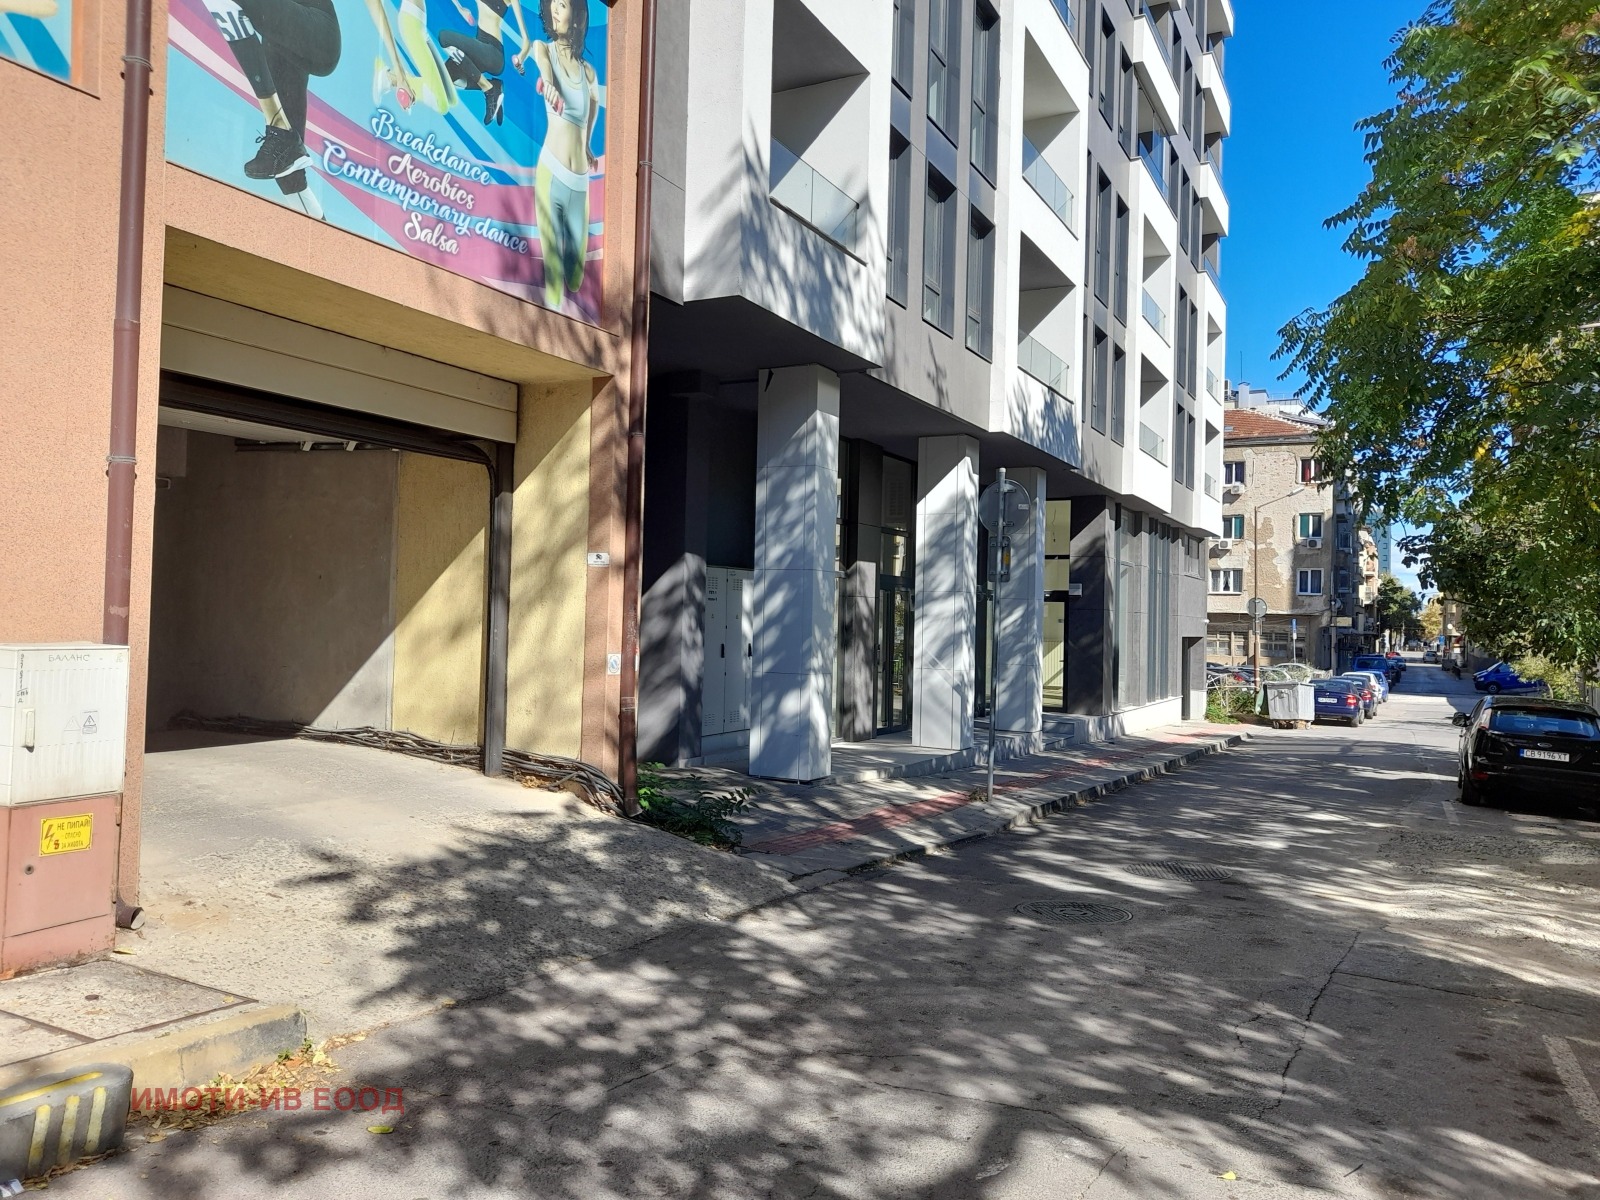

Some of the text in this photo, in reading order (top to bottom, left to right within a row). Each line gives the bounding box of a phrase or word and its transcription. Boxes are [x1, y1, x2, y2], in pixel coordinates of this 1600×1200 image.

[371, 108, 491, 186] Breakdance
[323, 140, 529, 254] Contemporary dance
[388, 153, 476, 210] Aerobics
[404, 211, 460, 255] Salsa
[48, 654, 90, 662] БАЛАНС
[57, 822, 65, 831] НЕ
